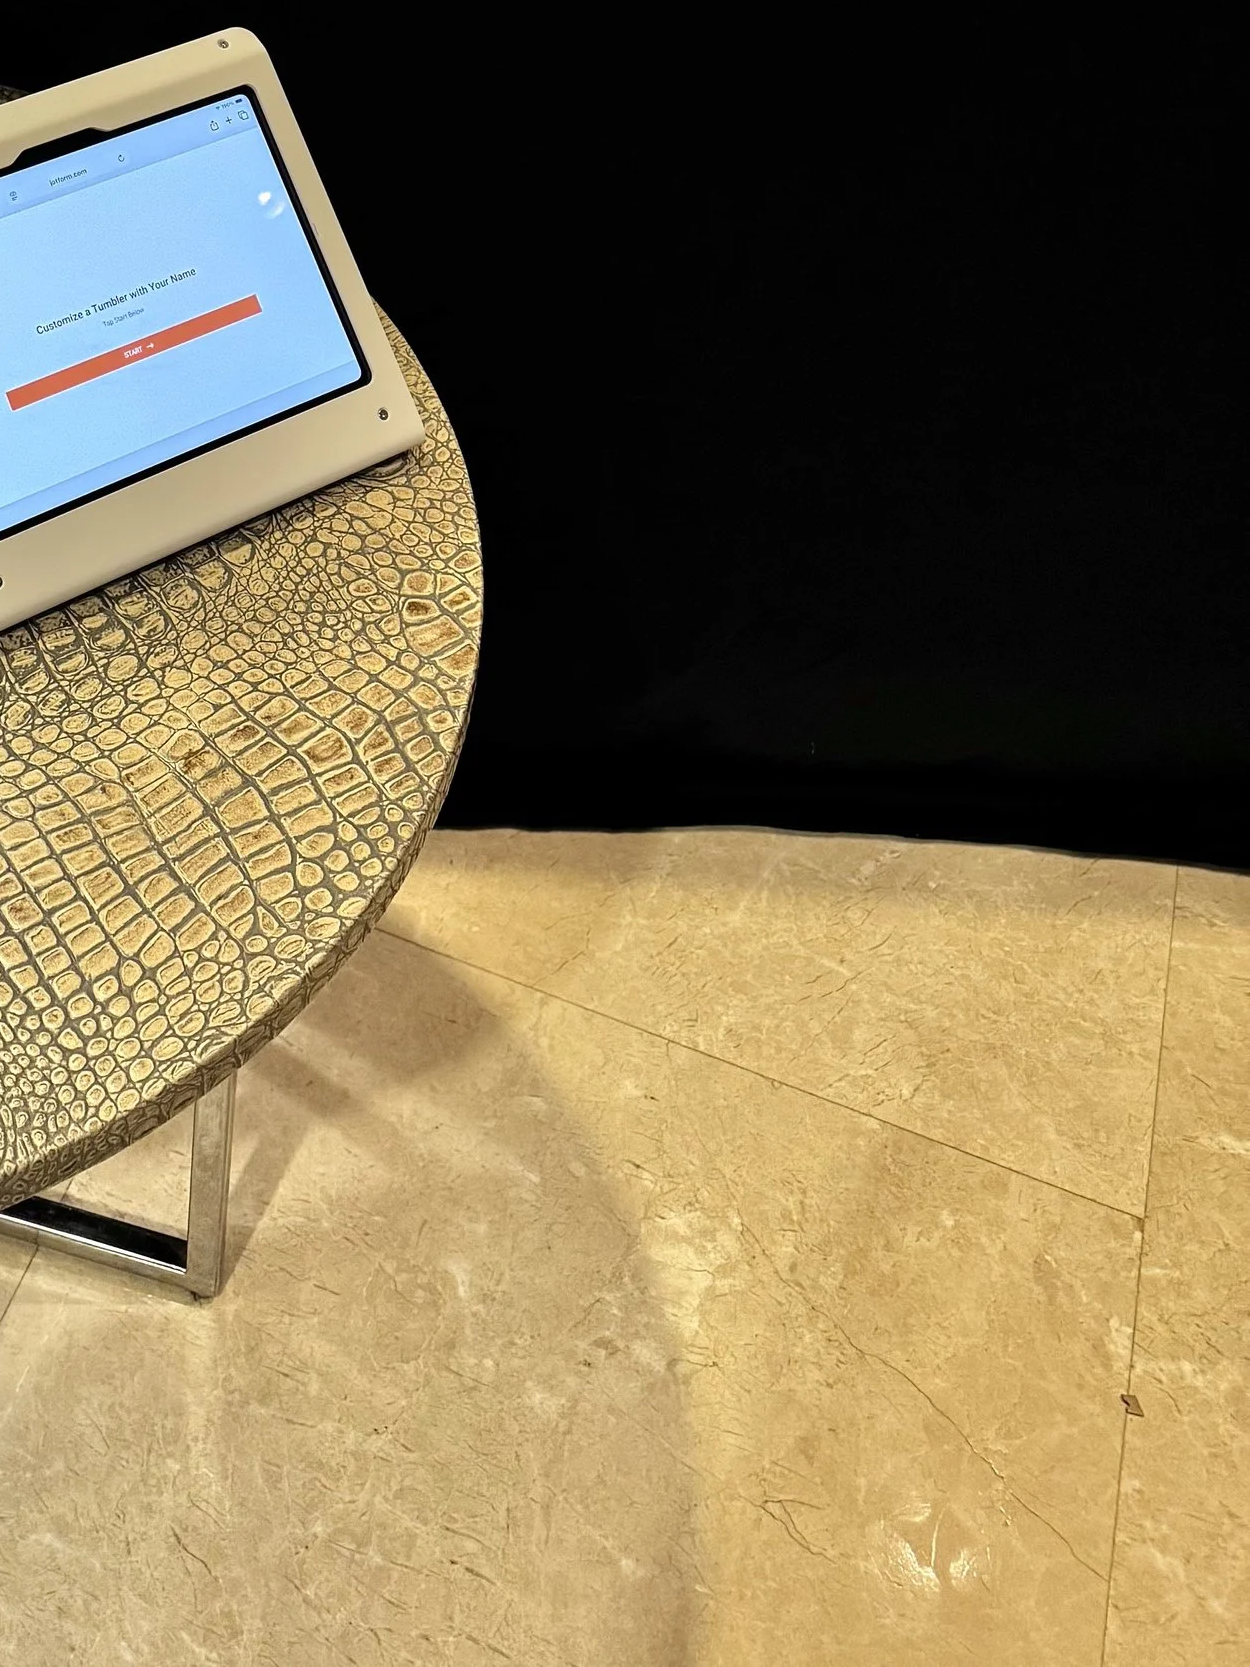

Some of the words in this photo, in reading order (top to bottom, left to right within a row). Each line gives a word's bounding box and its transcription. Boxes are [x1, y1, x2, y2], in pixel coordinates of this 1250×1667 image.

[36, 309, 84, 335] Customize
[84, 308, 92, 316] a
[91, 294, 129, 314] Tumbler
[129, 285, 149, 300] with
[148, 277, 169, 292] Your
[170, 267, 197, 284] Name
[123, 345, 143, 359] START
